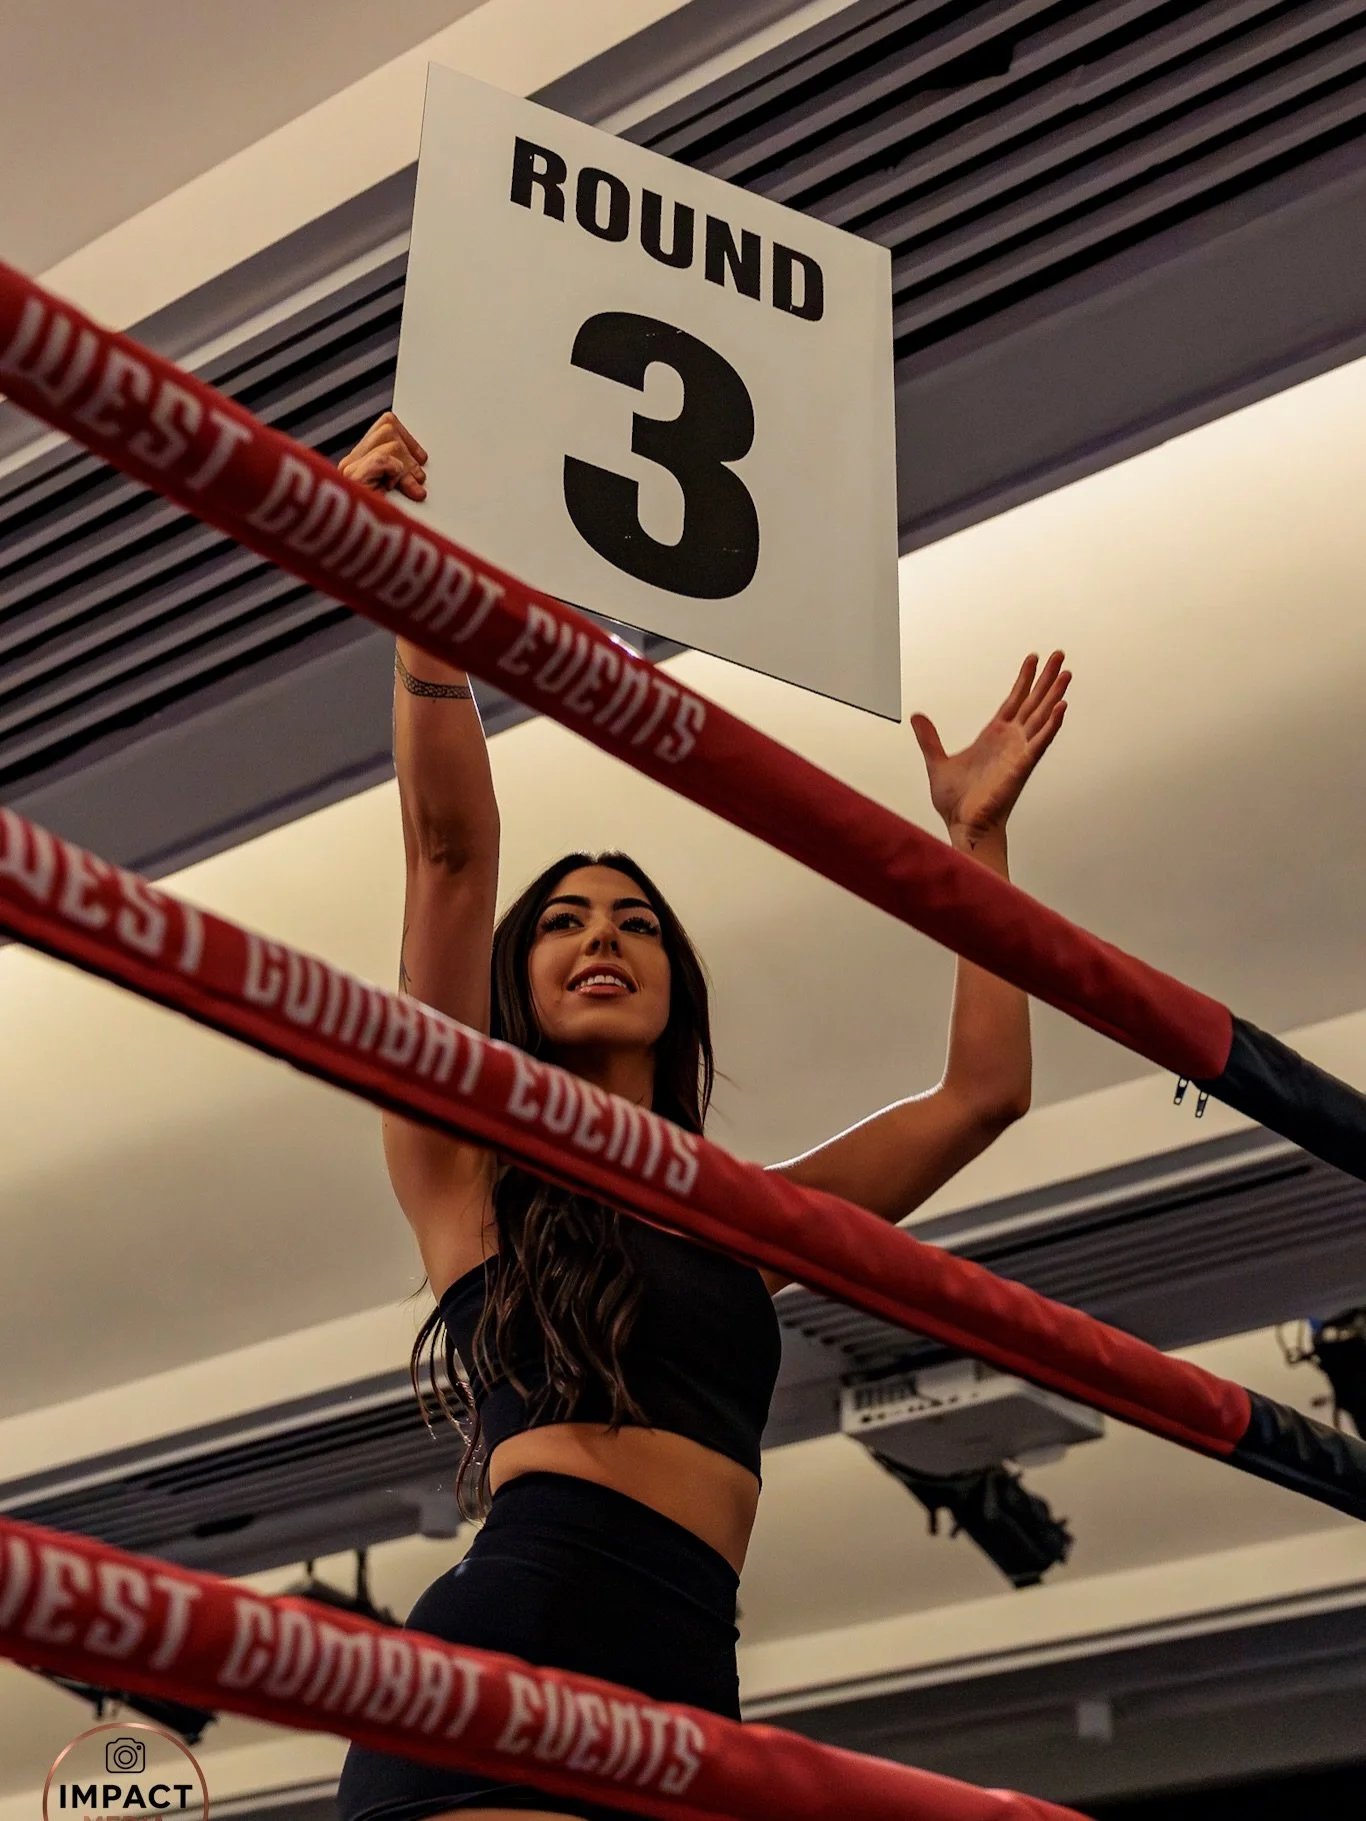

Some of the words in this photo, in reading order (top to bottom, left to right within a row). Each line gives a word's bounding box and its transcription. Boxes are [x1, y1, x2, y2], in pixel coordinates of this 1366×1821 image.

[510, 136, 824, 322] ROUND
[0, 298, 253, 490] WEST
[248, 454, 508, 645] COMBAT
[497, 605, 707, 764] EVENTS
[563, 311, 760, 600] 3
[242, 930, 487, 1096] COMBAT
[506, 1045, 702, 1197] EVENTS
[217, 1596, 486, 1738] COMBAT
[494, 1674, 707, 1795] EVENTS
